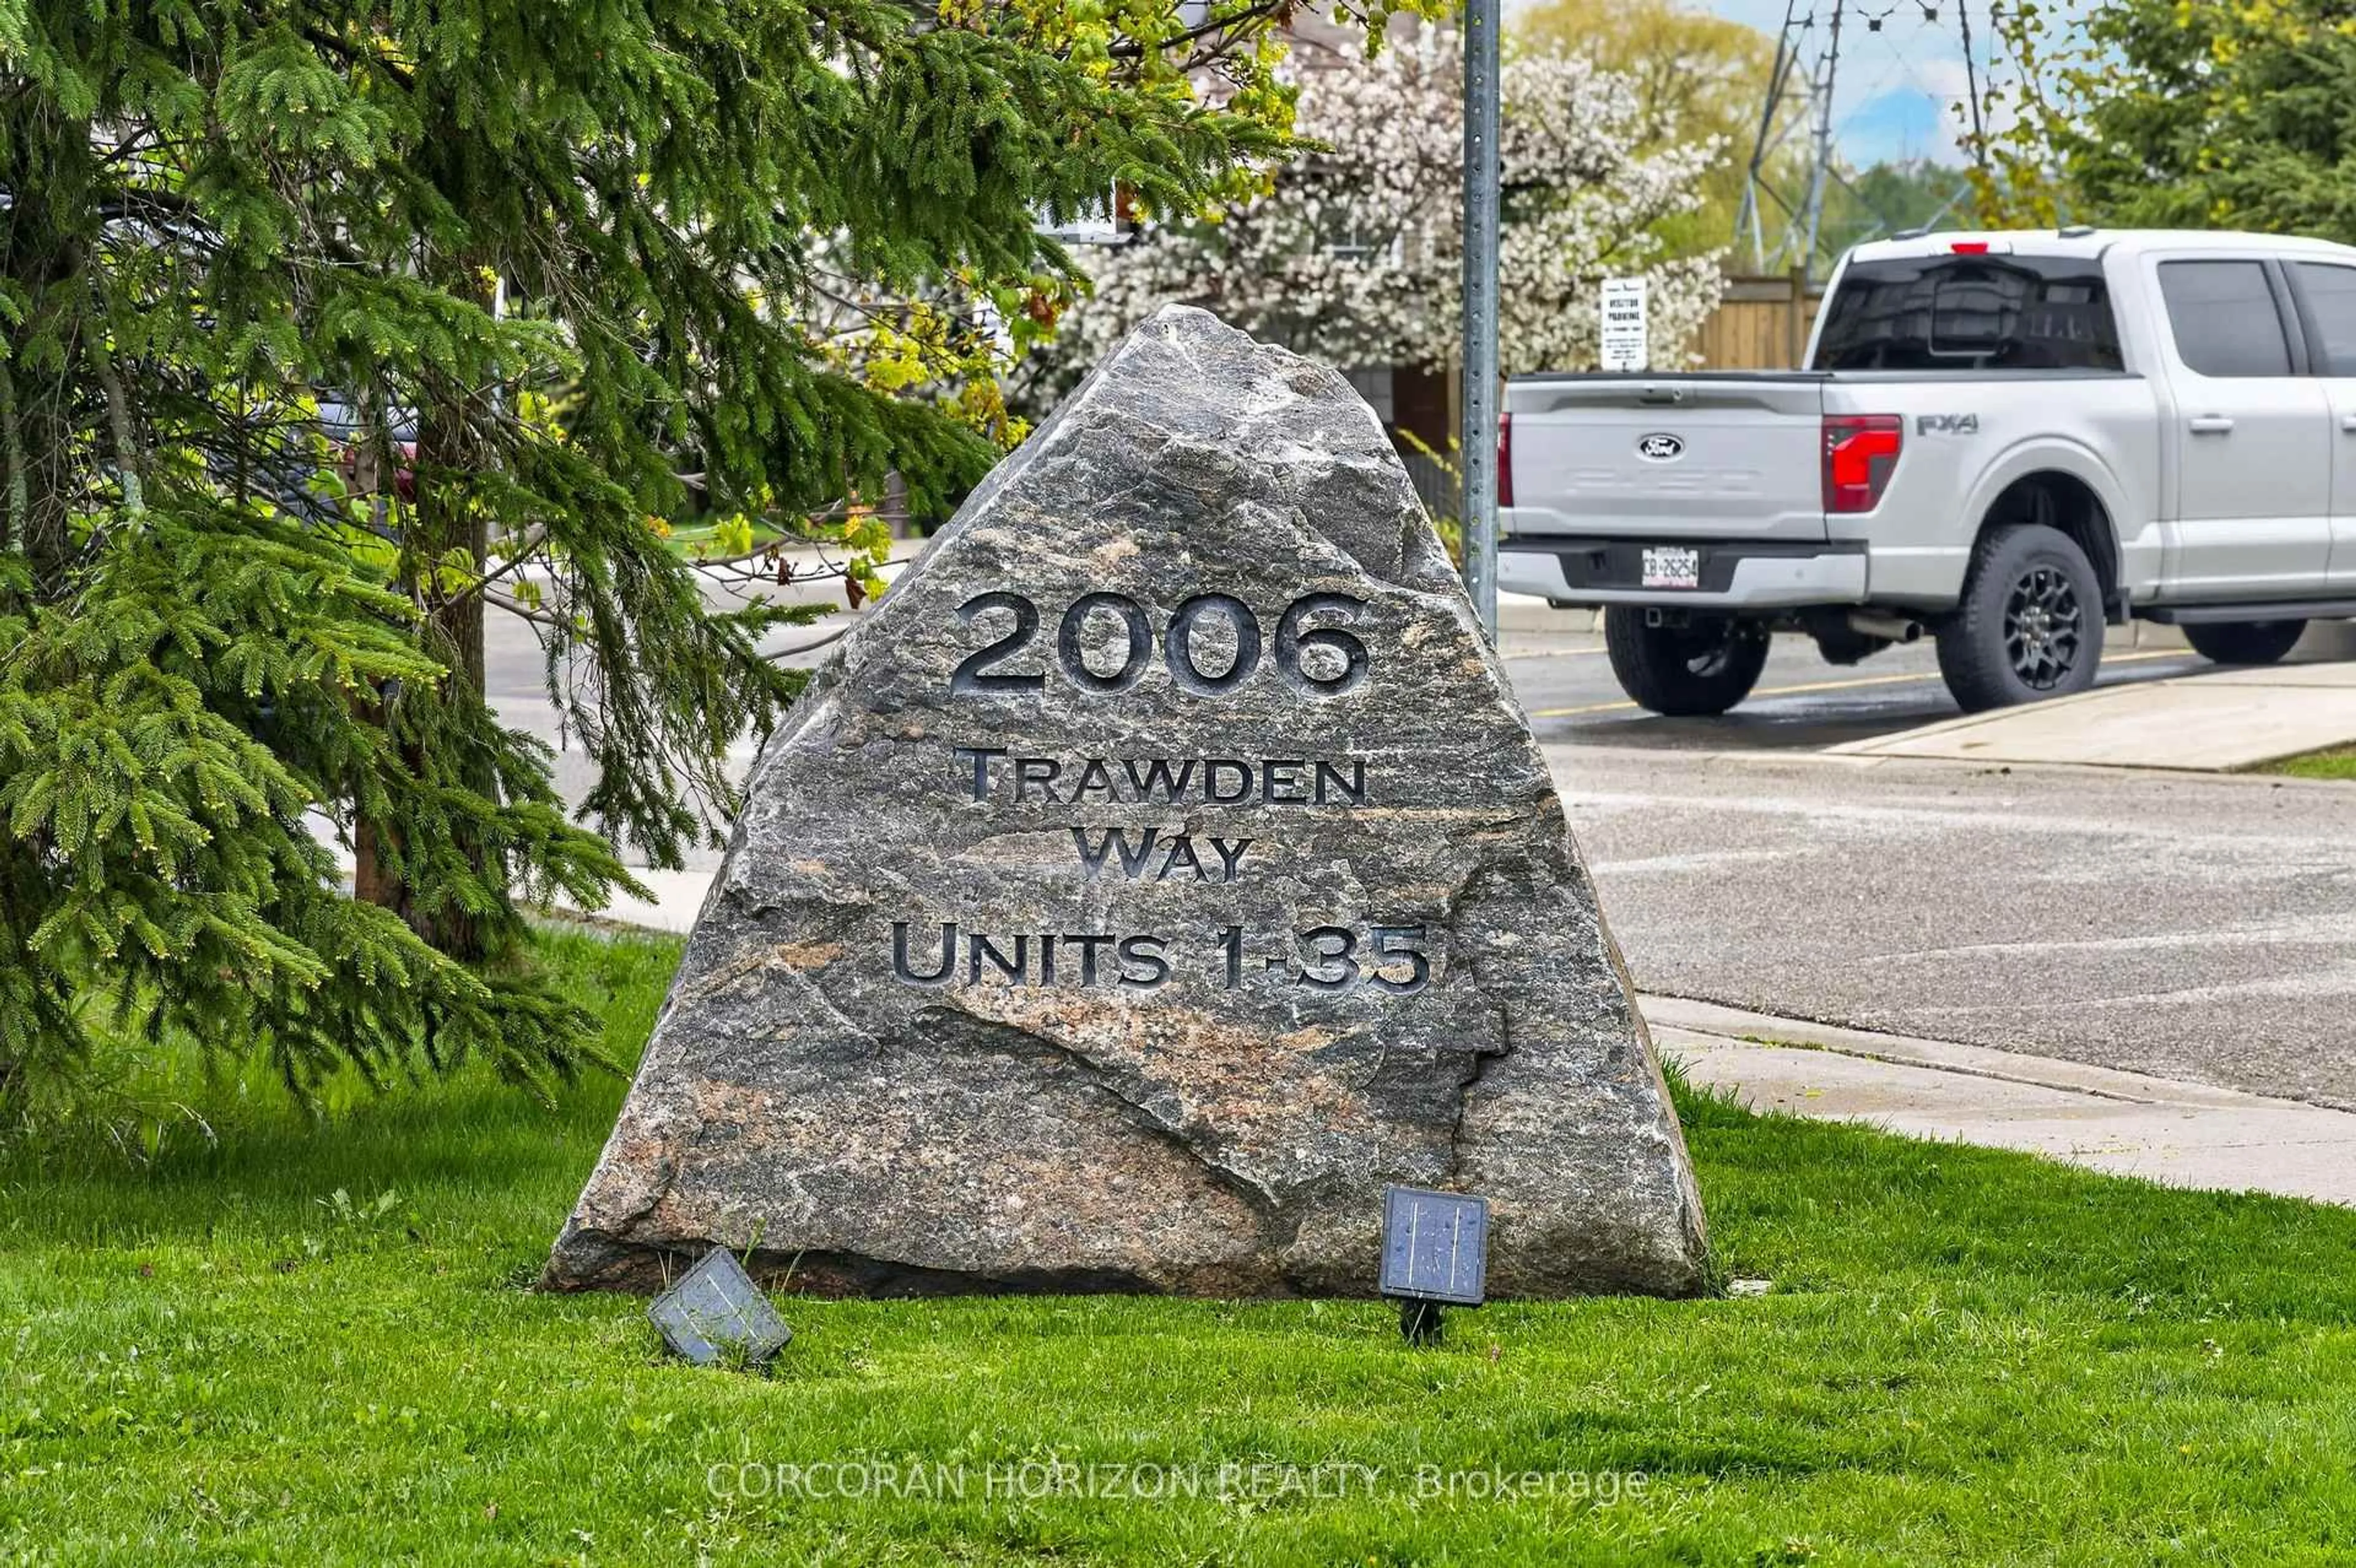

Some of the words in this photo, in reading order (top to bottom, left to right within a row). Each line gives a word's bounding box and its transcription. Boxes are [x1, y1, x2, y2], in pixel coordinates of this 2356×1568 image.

[1917, 413, 1979, 436] FX4
[951, 591, 1369, 698] 2006
[952, 746, 1367, 806] TRAWDEN
[1070, 826, 1256, 883] WAY
[890, 921, 1171, 990] UNITS
[1217, 924, 1431, 994] 1-35
